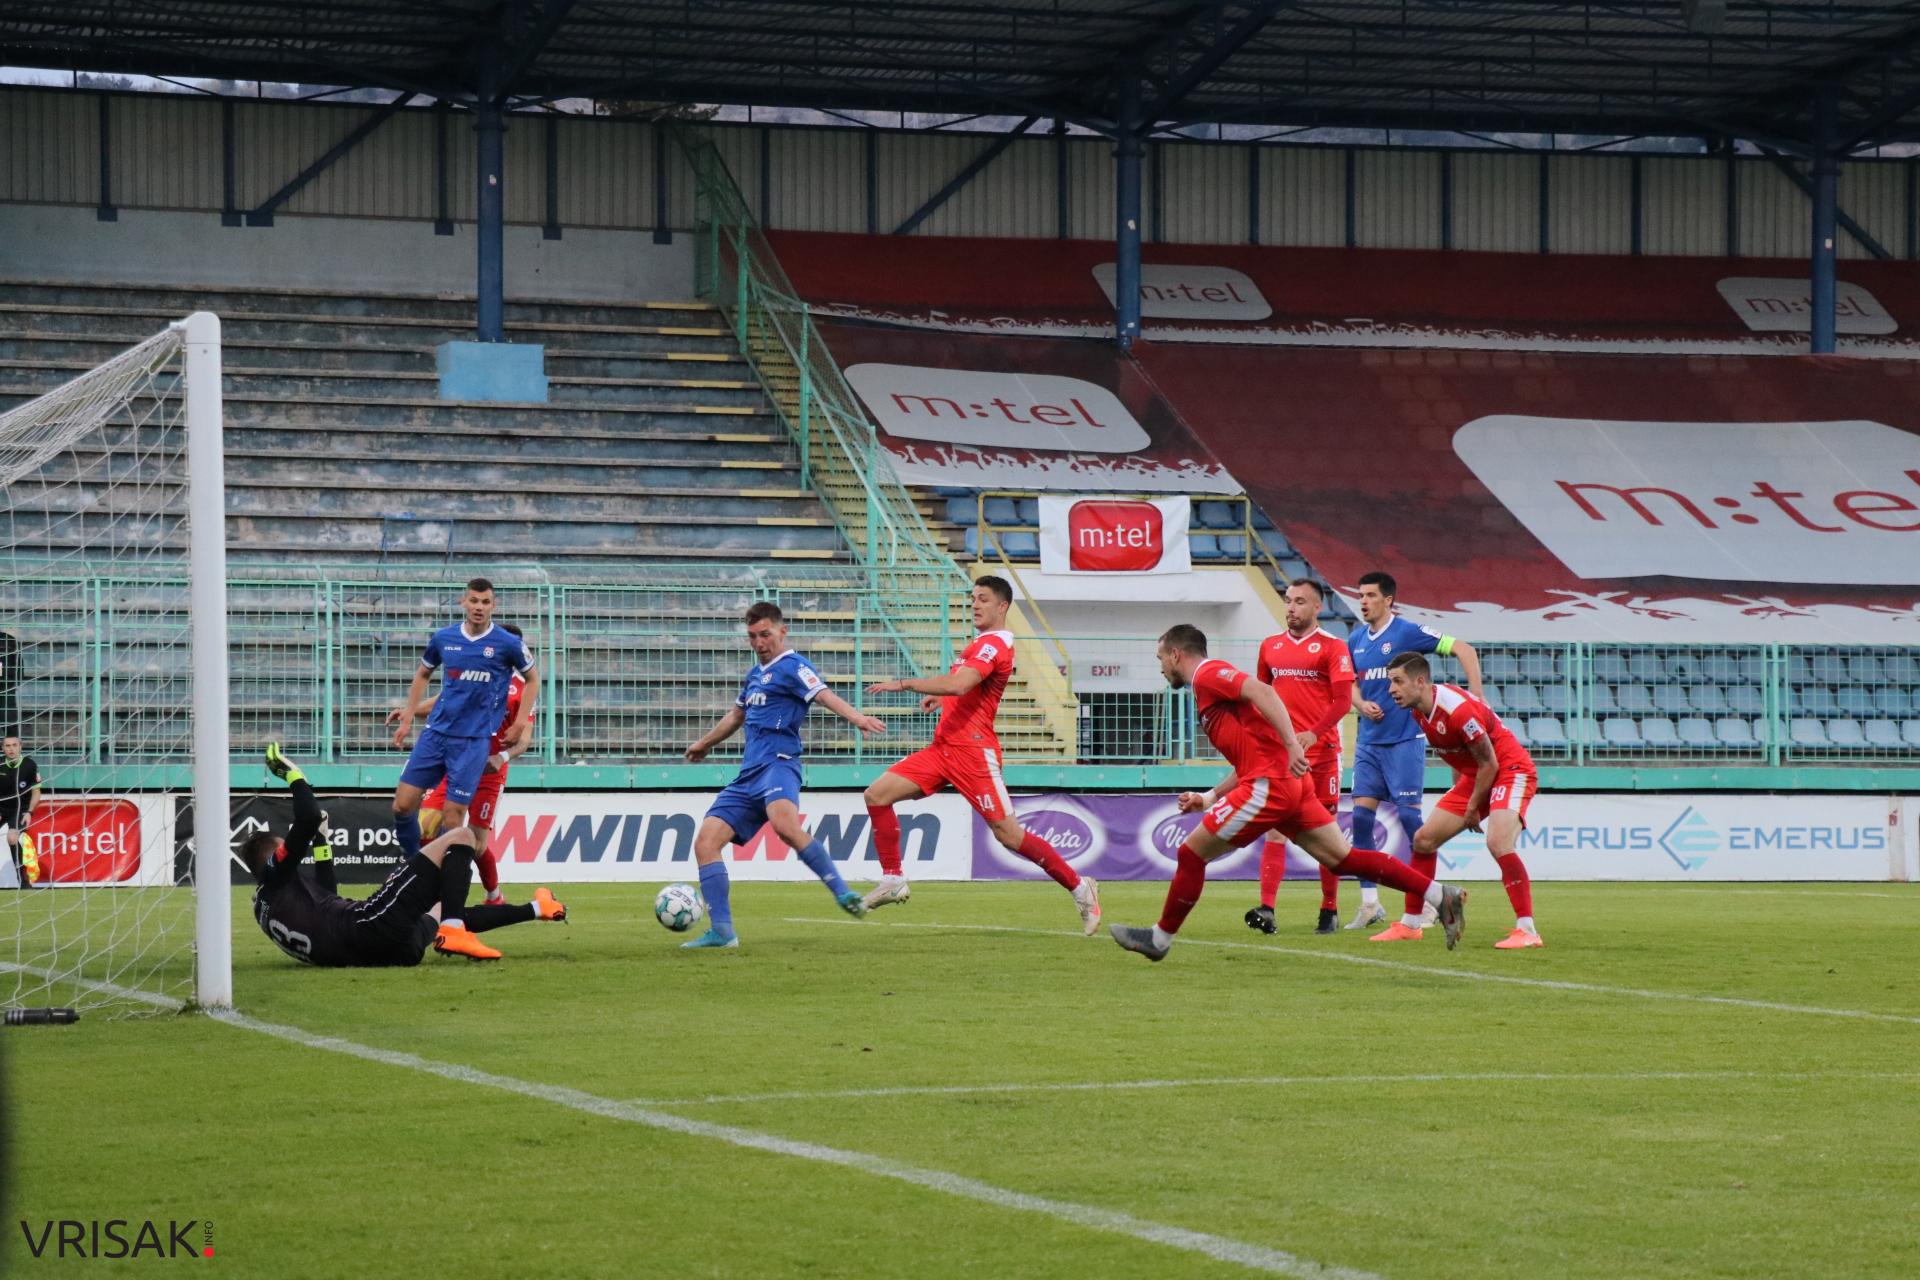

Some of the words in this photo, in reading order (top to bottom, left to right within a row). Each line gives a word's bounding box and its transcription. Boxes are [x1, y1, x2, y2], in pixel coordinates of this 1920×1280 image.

[890, 391, 1106, 428] m:tel
[1079, 520, 1152, 548] m:tel
[1091, 665, 1120, 677] EXIT
[1329, 776, 1337, 795] 6
[480, 802, 491, 820] 8
[1210, 796, 1234, 824] 24
[37, 823, 127, 855] m:tel
[1514, 827, 1653, 850] MERUS
[1729, 827, 1885, 850] EMERUS
[363, 855, 398, 864] Mostar
